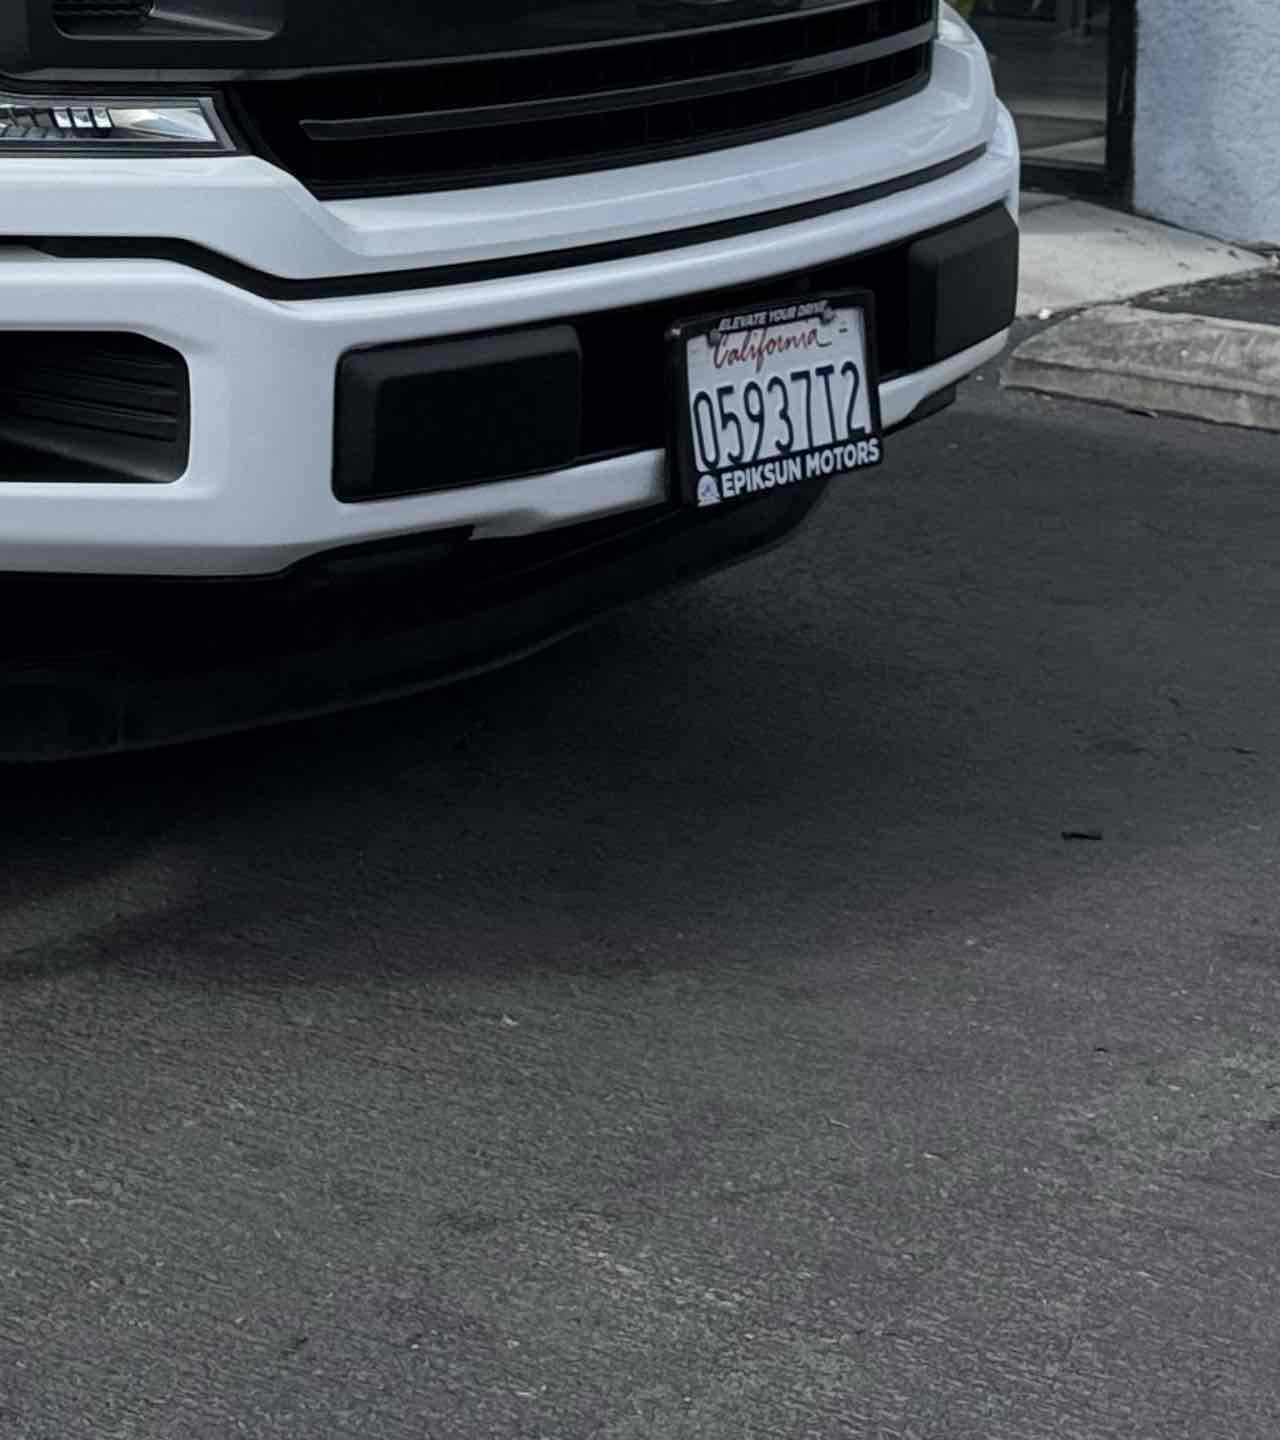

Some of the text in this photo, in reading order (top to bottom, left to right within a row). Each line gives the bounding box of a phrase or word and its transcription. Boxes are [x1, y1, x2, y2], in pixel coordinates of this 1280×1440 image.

[713, 326, 832, 374] California
[693, 361, 868, 469] 05937T2
[721, 437, 880, 499] EPIKSUN MOTORS
